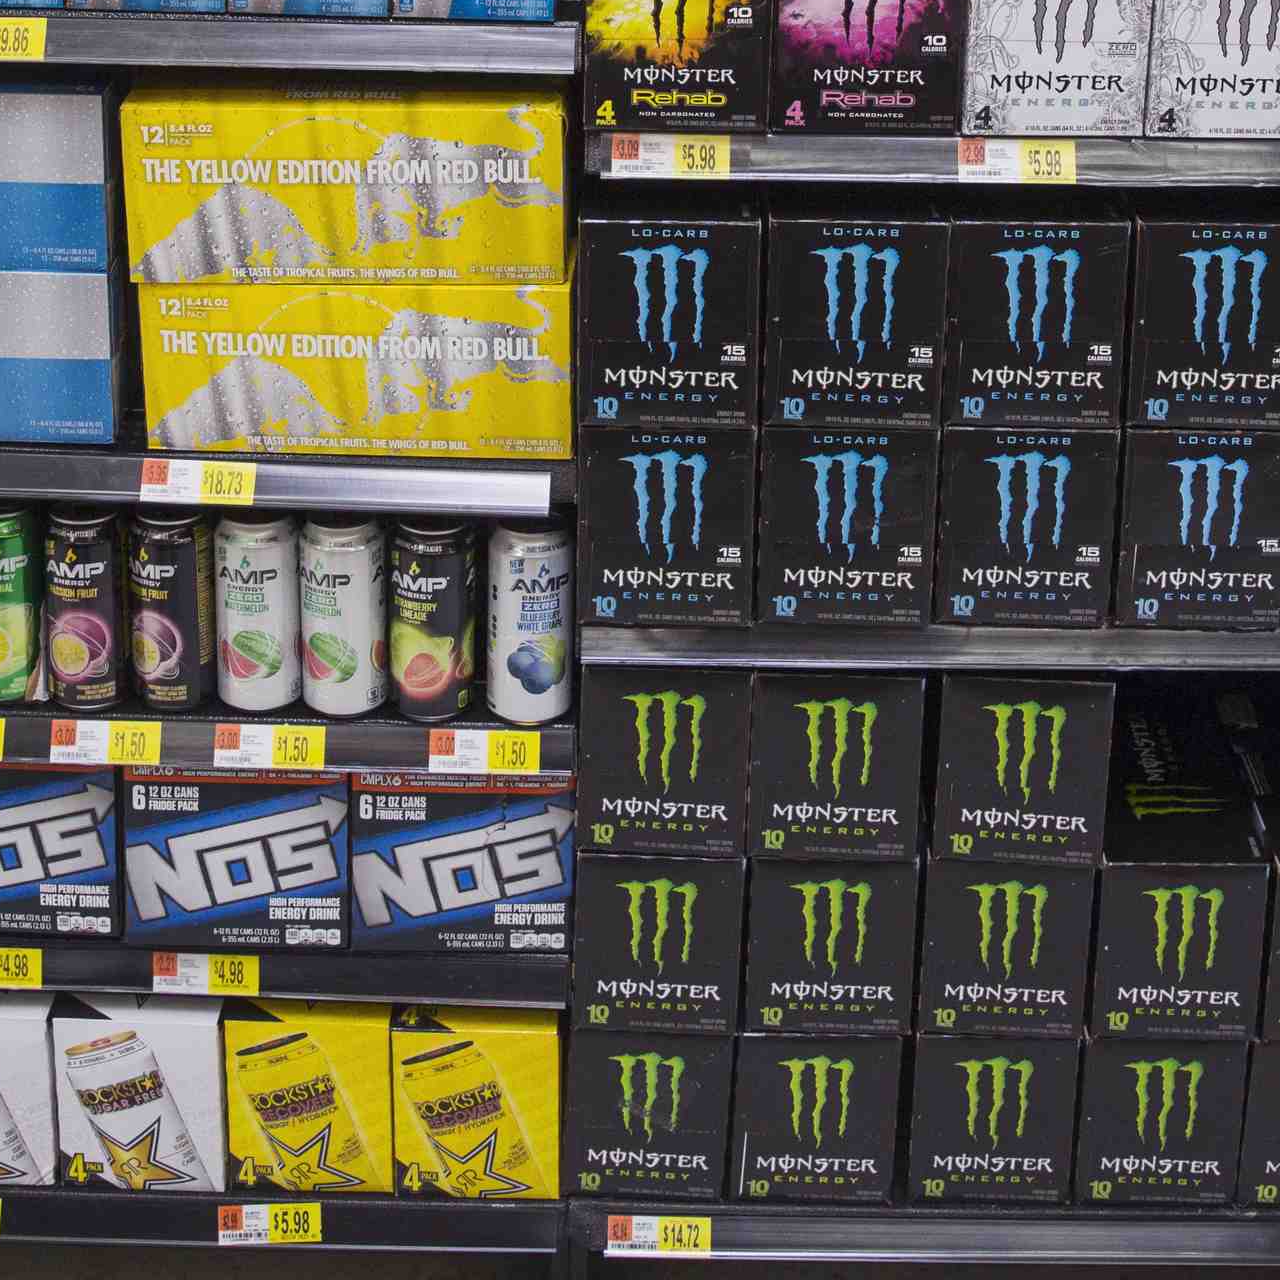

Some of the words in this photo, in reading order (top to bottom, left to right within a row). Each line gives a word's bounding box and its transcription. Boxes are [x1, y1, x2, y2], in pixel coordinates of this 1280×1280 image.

[142, 126, 164, 144] 12
[682, 145, 716, 171] $5.98
[143, 159, 180, 182] THE
[184, 159, 272, 184] YELLOW
[276, 160, 362, 184] EDITION
[367, 160, 432, 184] FROM
[437, 160, 479, 184] RED
[484, 160, 541, 184] BULL.
[605, 366, 740, 390] MONSTER
[624, 392, 718, 403] ENERGY
[220, 567, 279, 585] AMP
[602, 797, 727, 822] MONSTER
[40, 894, 79, 907] ENERGY
[82, 895, 110, 908] DRINK
